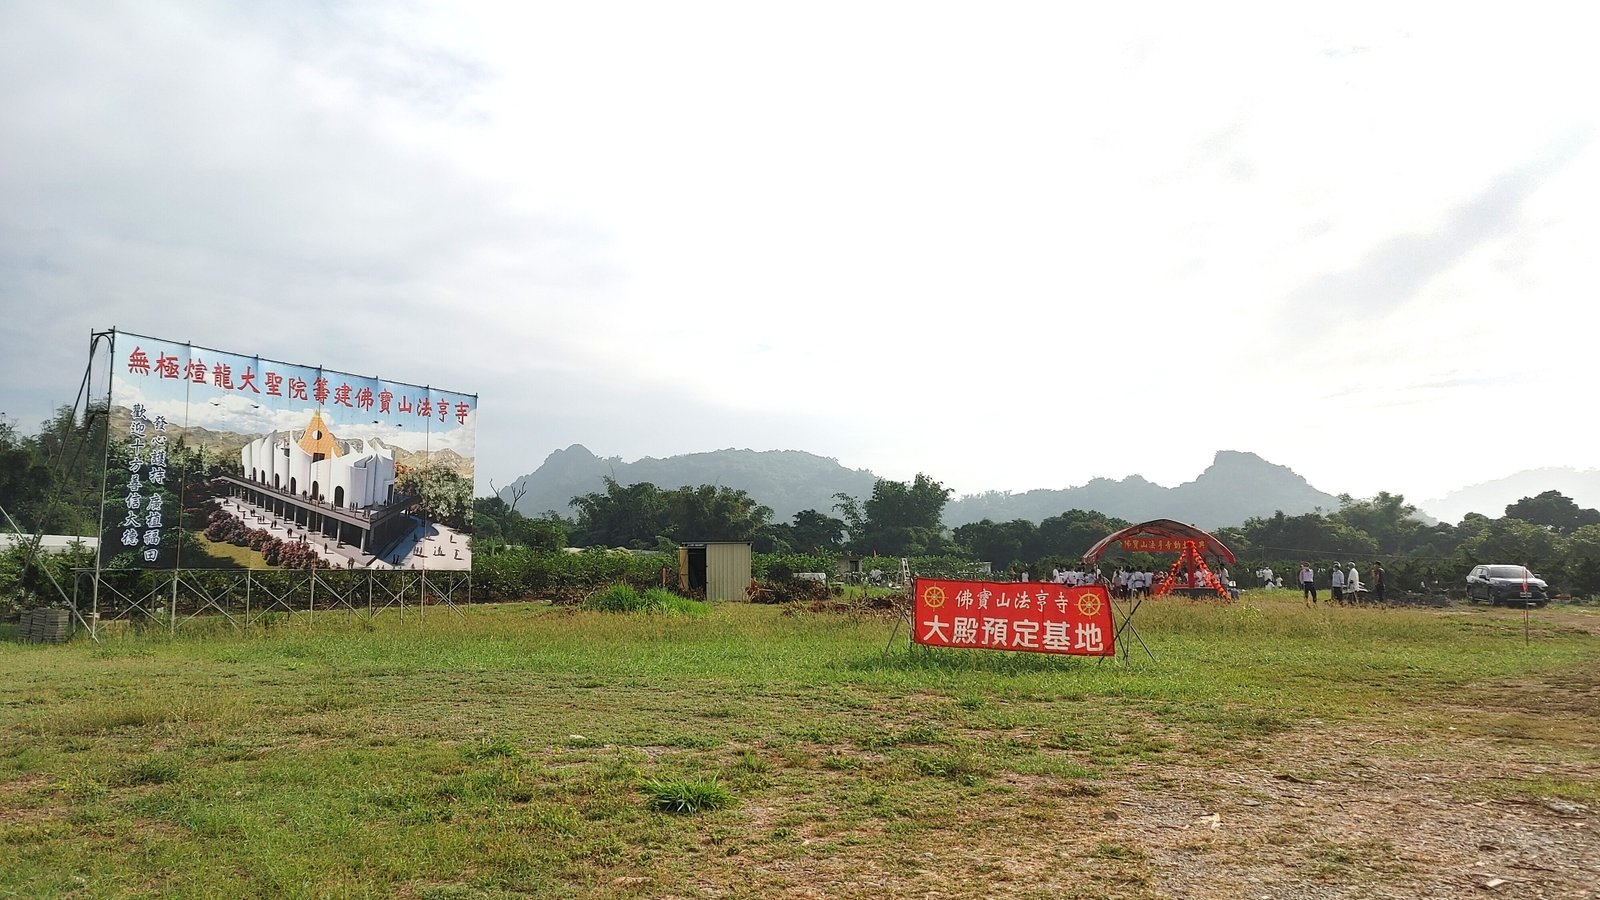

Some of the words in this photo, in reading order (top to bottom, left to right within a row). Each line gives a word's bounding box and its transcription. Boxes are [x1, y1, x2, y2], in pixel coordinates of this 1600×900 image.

[120, 402, 147, 547] 歡迎十方善信大德
[148, 415, 168, 485] 發心護持
[142, 492, 164, 562] 廣植福田
[922, 615, 1104, 653] 大殿預定基地
[955, 587, 1069, 615] 佛寶山法亨寺
